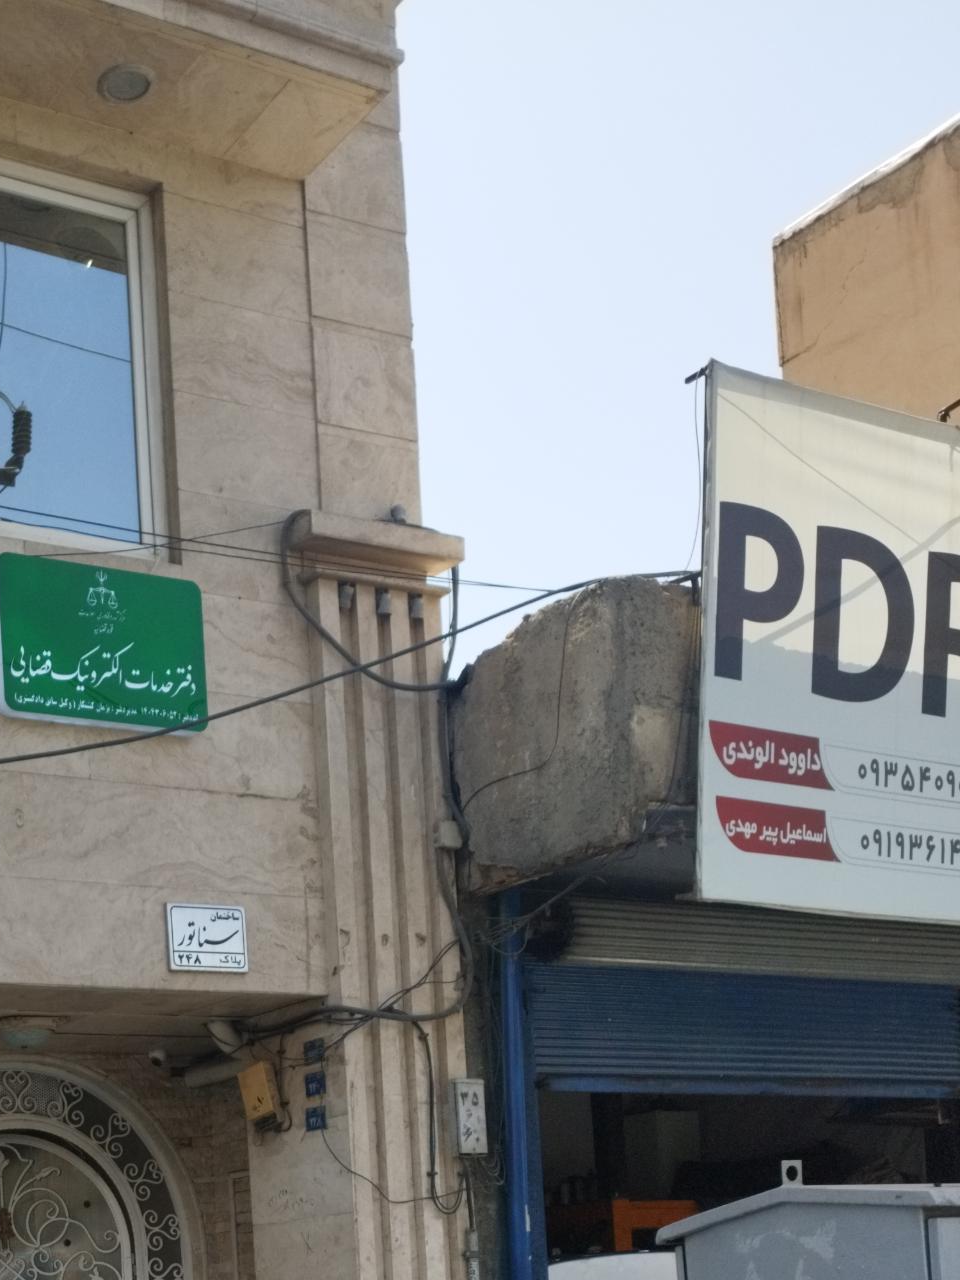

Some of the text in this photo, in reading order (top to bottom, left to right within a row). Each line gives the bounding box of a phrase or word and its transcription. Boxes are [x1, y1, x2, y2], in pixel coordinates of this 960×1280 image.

[50, 642, 135, 691] الکترونیک
[124, 669, 174, 693] خدمات
[170, 664, 197, 698] دفتر
[723, 740, 821, 776] داوود الوندی
[858, 758, 960, 797] ۰۹۳۵۴۰۹
[725, 818, 827, 846] اسماعیل پیر مهدی
[210, 911, 240, 922] ساختمان
[220, 955, 241, 965] پلاک
